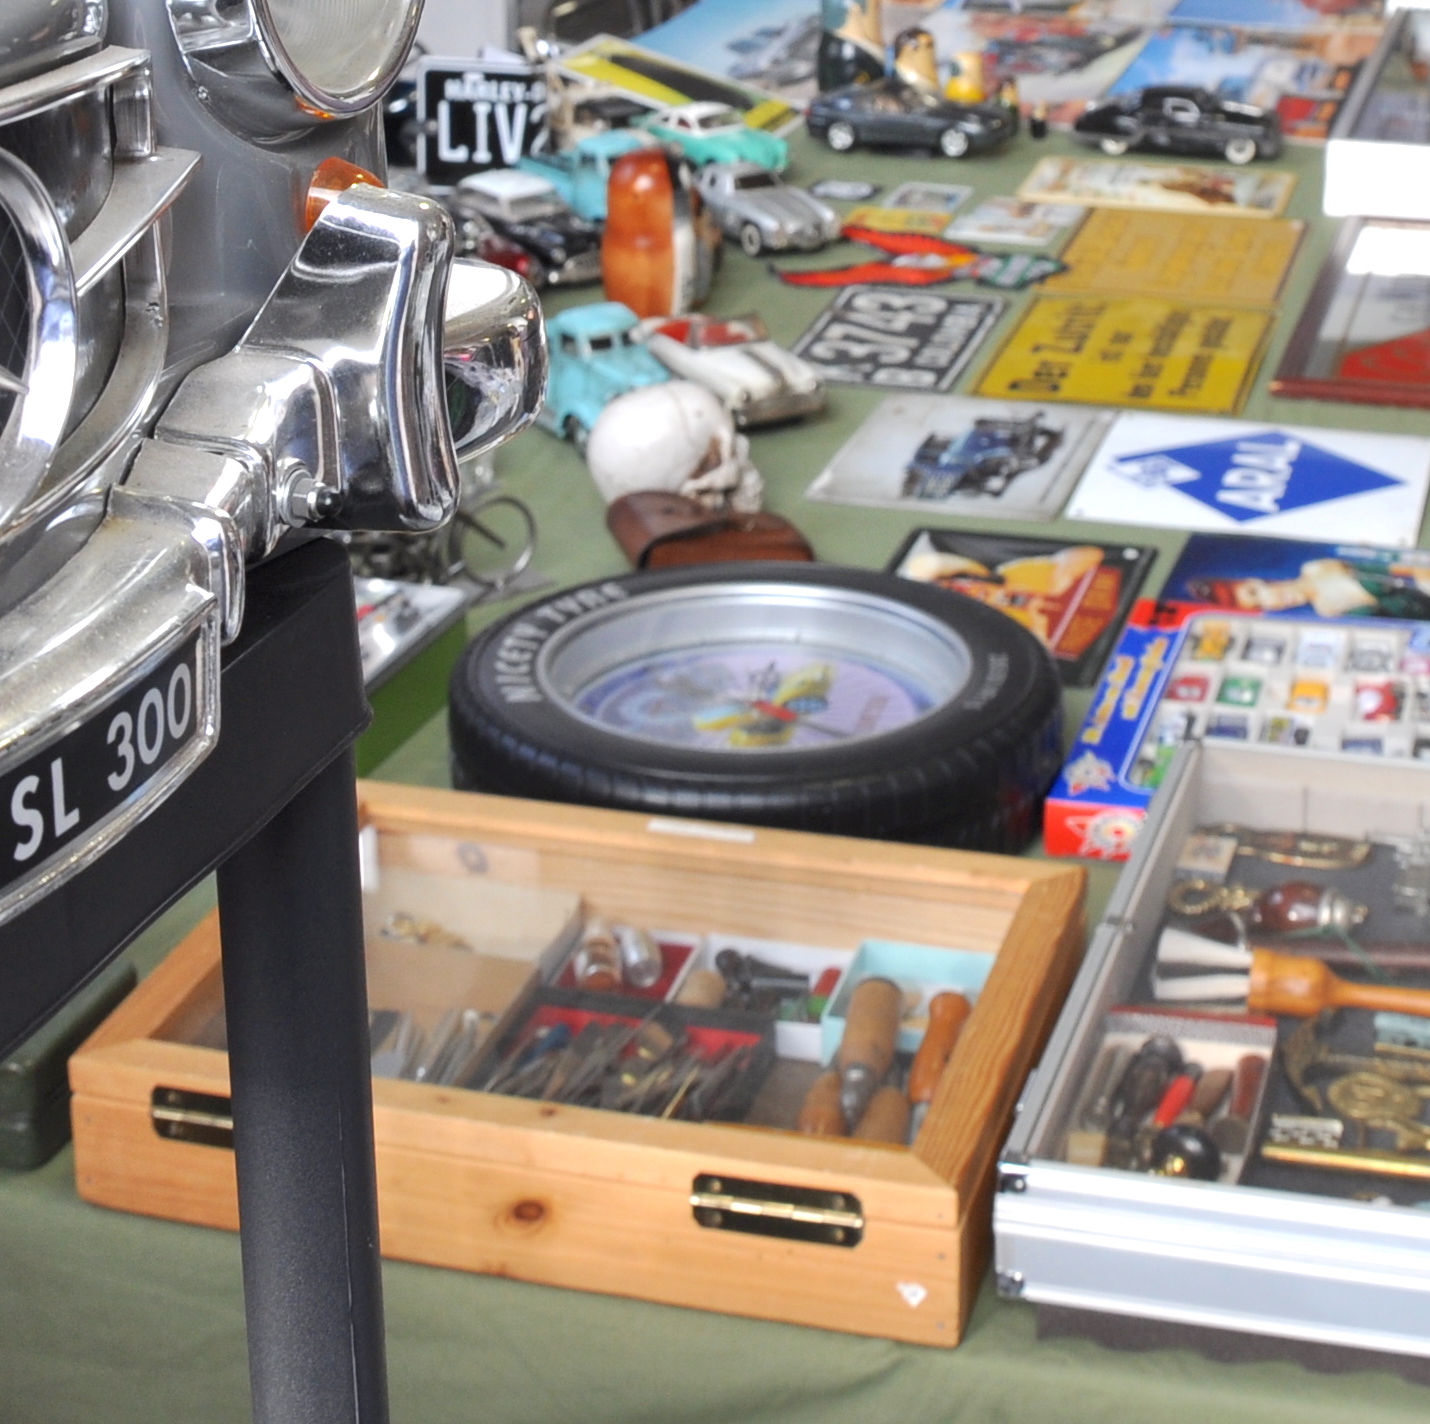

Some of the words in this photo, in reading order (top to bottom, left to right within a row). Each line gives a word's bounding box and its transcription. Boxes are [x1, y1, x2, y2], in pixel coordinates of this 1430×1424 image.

[444, 72, 547, 105] HARLEY-D
[1214, 441, 1301, 512] ARAL
[11, 757, 80, 862] SL
[107, 663, 191, 792] 300
